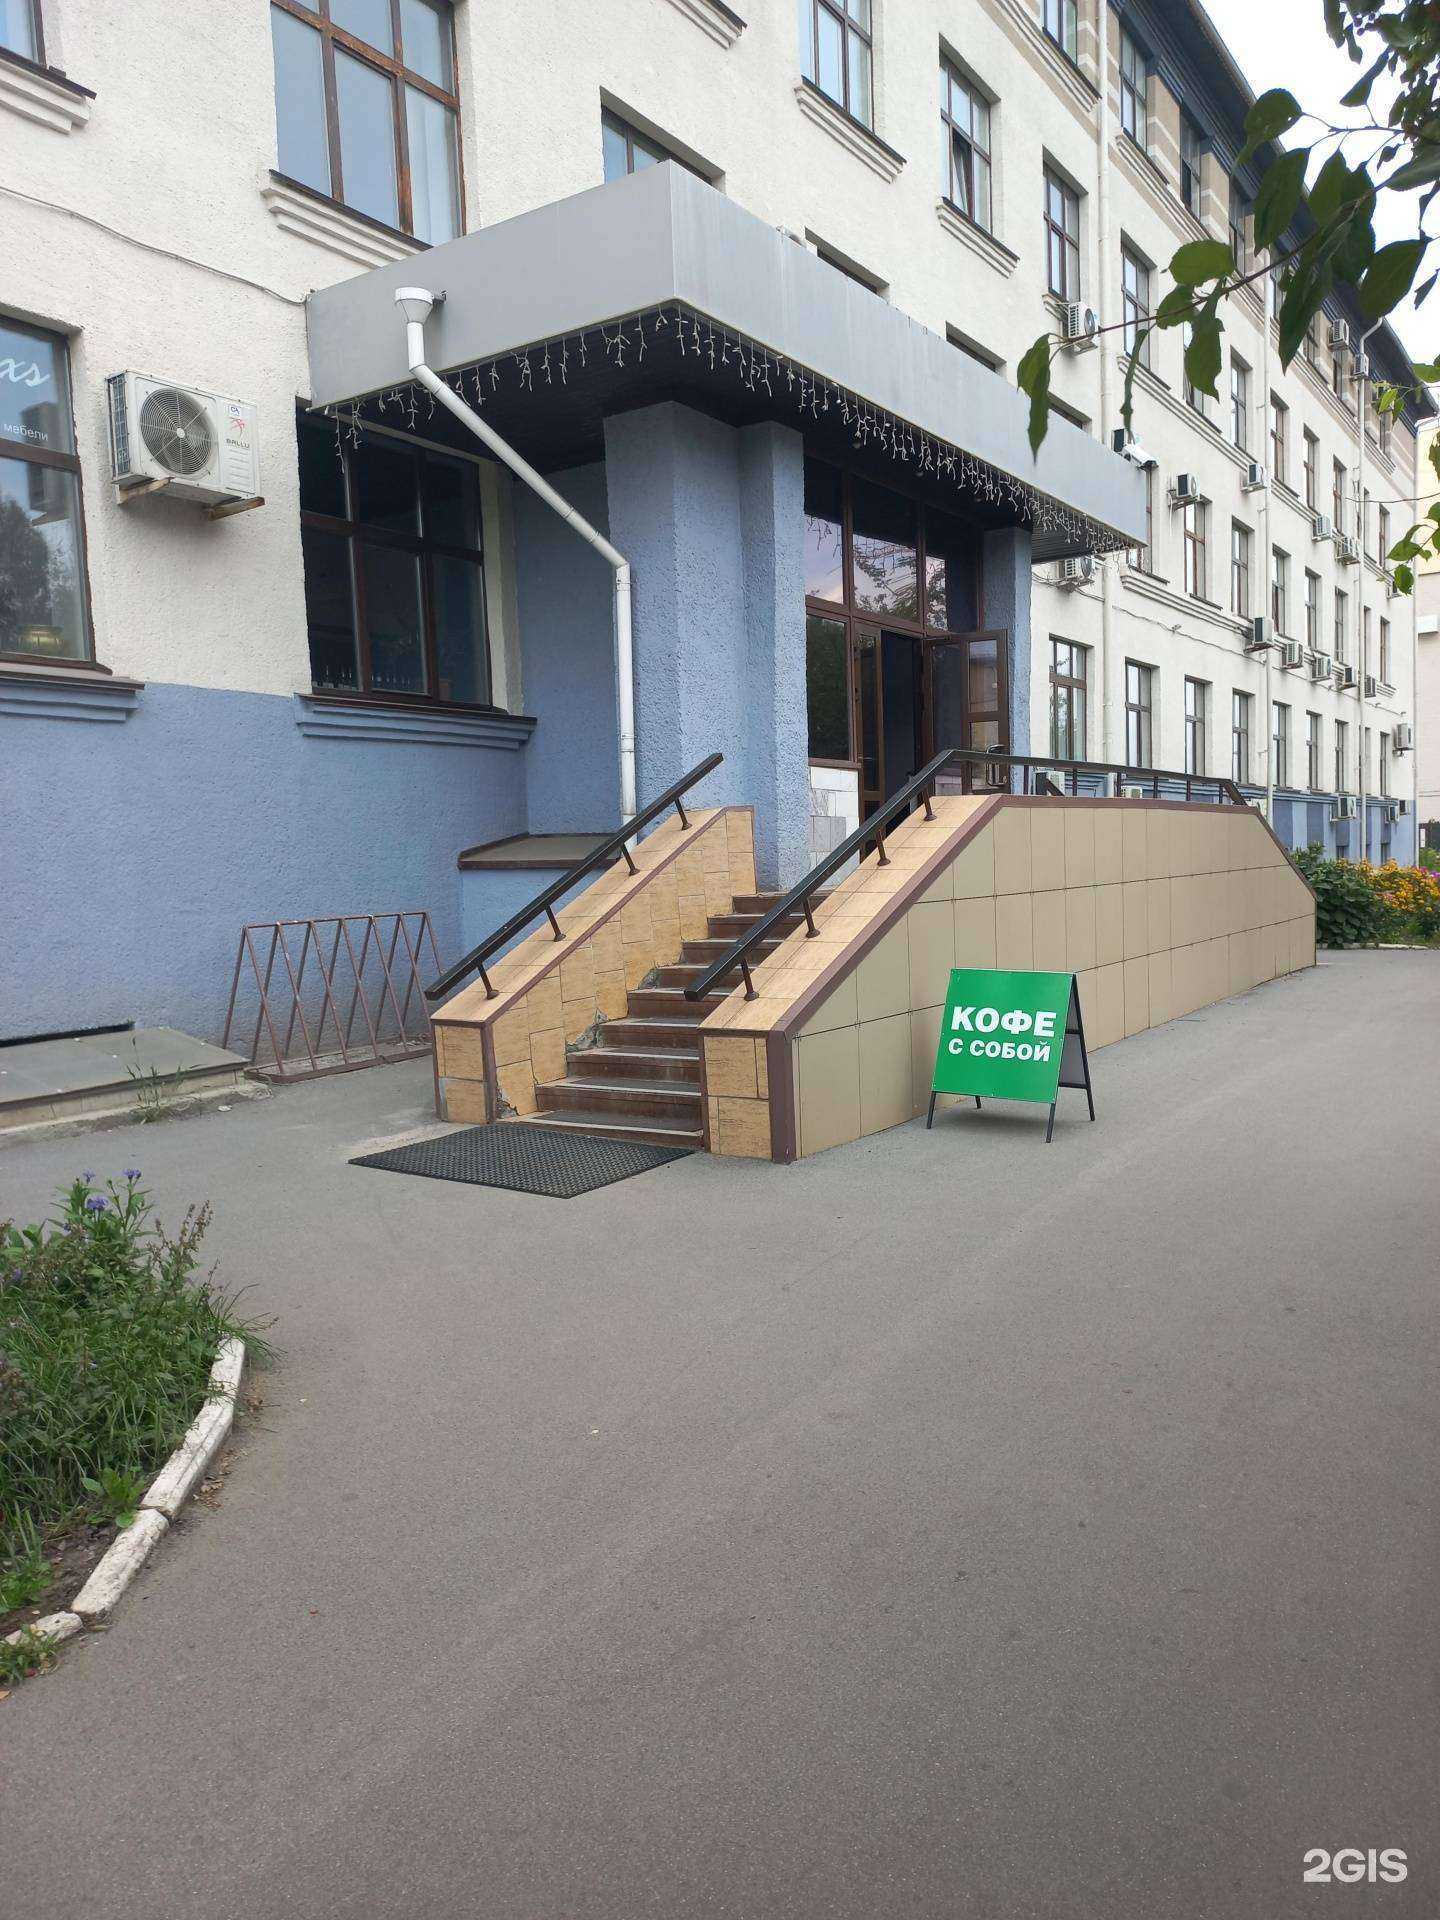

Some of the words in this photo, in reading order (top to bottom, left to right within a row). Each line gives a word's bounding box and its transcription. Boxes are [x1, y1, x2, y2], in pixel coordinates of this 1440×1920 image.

[3, 423, 48, 441] мебели
[951, 1006, 1057, 1037] КОФЕ
[949, 1038, 963, 1054] С
[969, 1040, 1051, 1062] СОБОЙ
